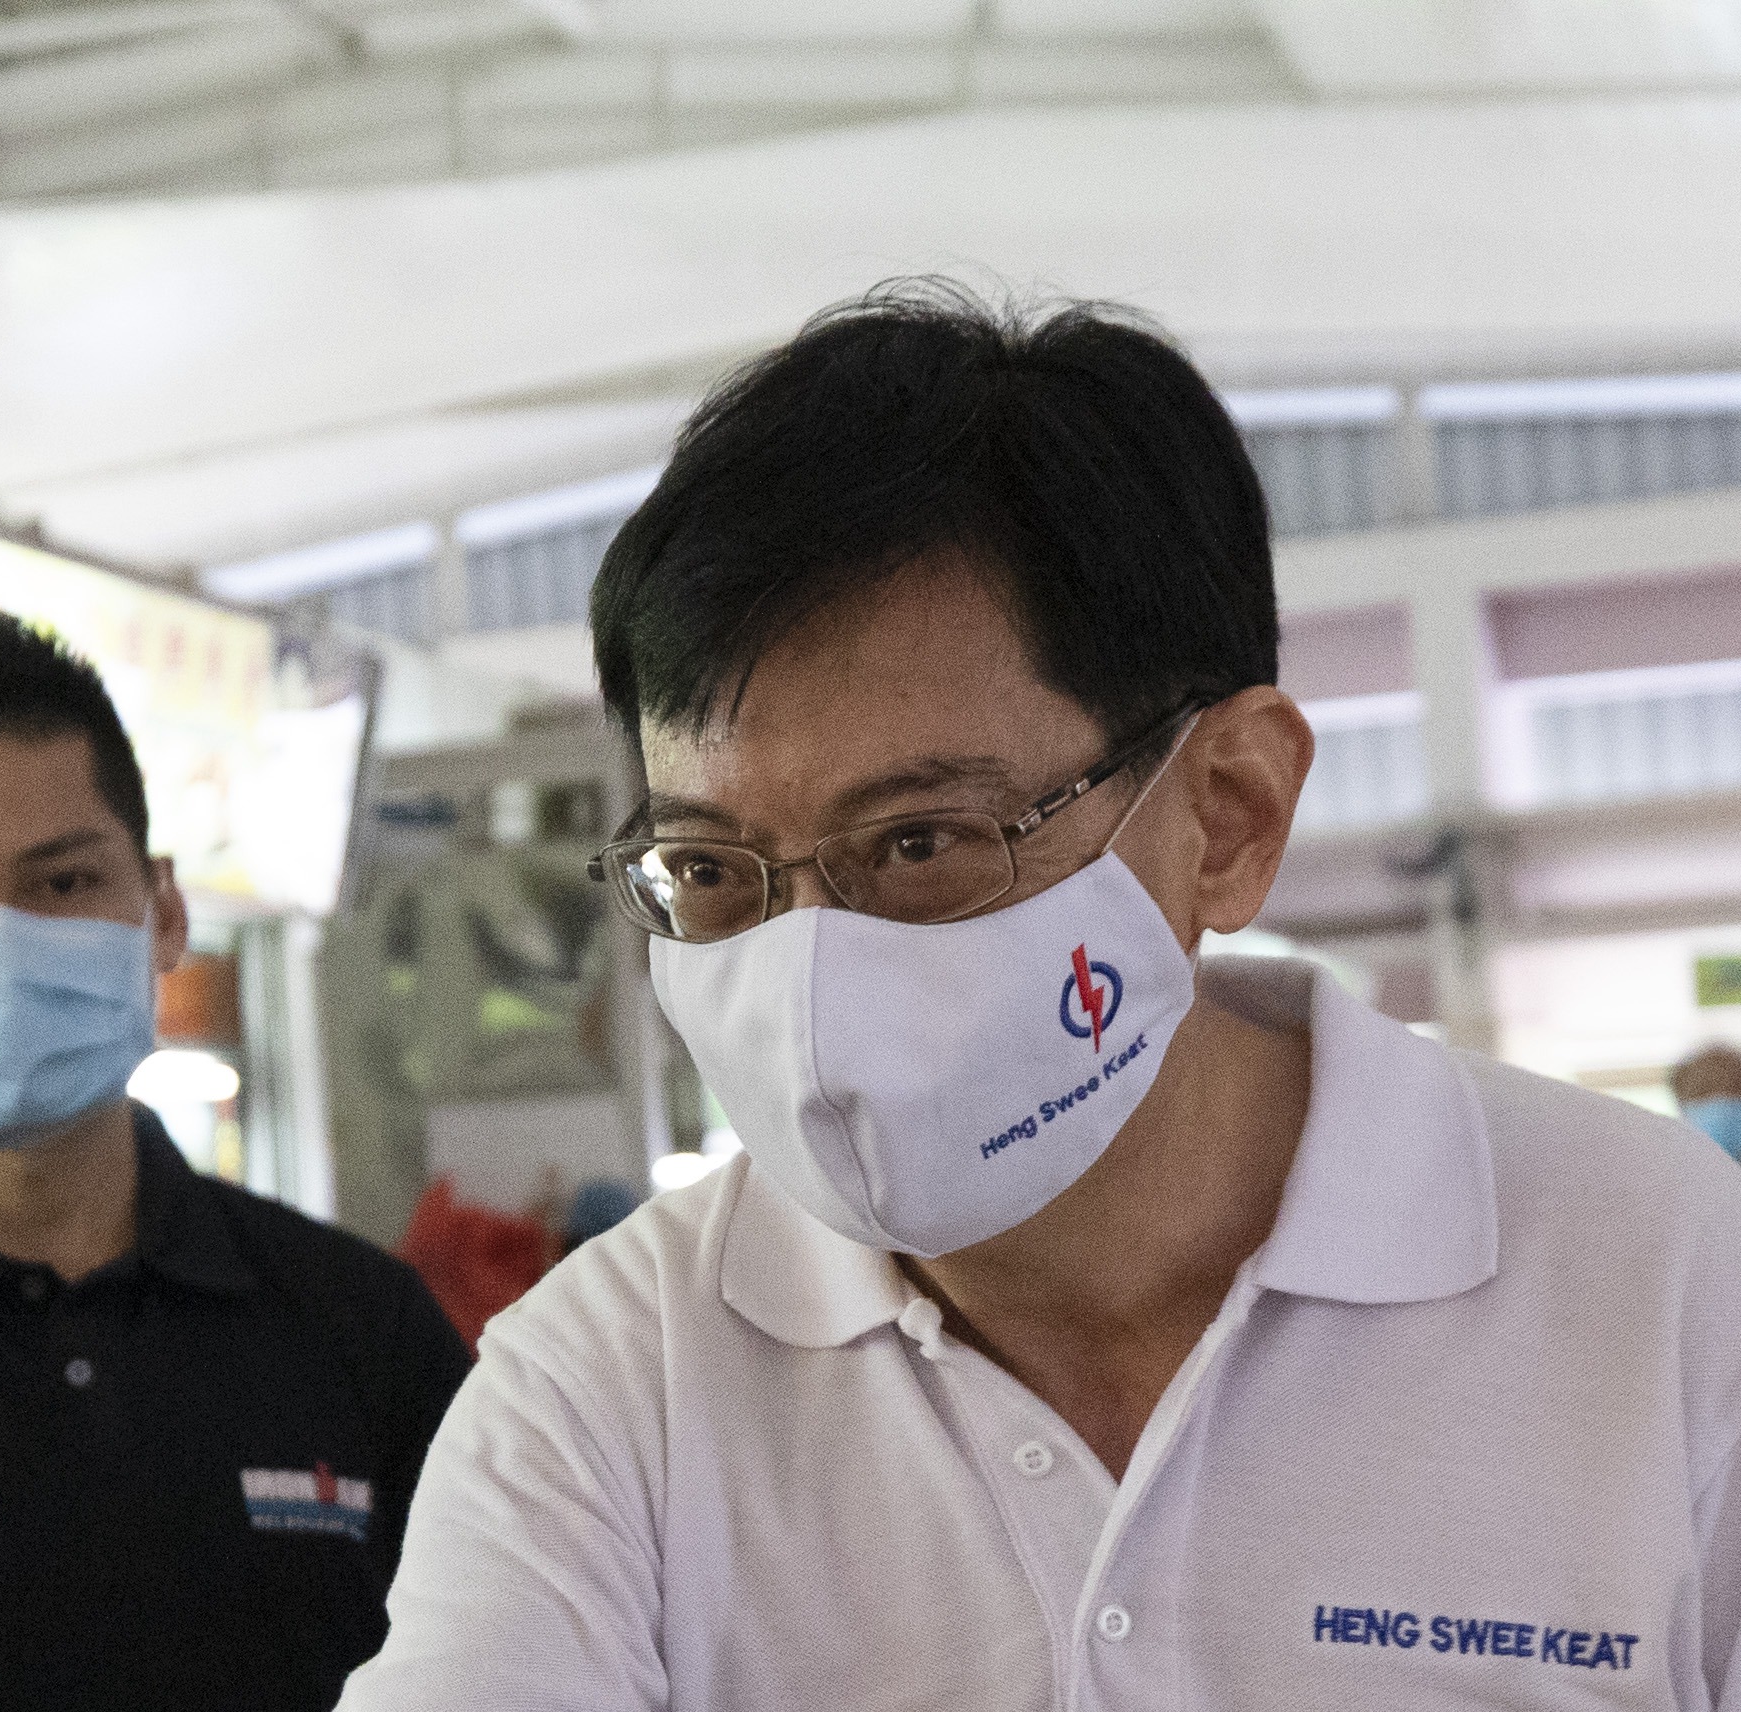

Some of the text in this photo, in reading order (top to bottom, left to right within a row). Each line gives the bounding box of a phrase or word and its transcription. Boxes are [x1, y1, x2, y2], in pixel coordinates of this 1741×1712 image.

[980, 1032, 1149, 1160] Heng Swee Keat
[1314, 1604, 1641, 1671] HENG SWEE KEAT
